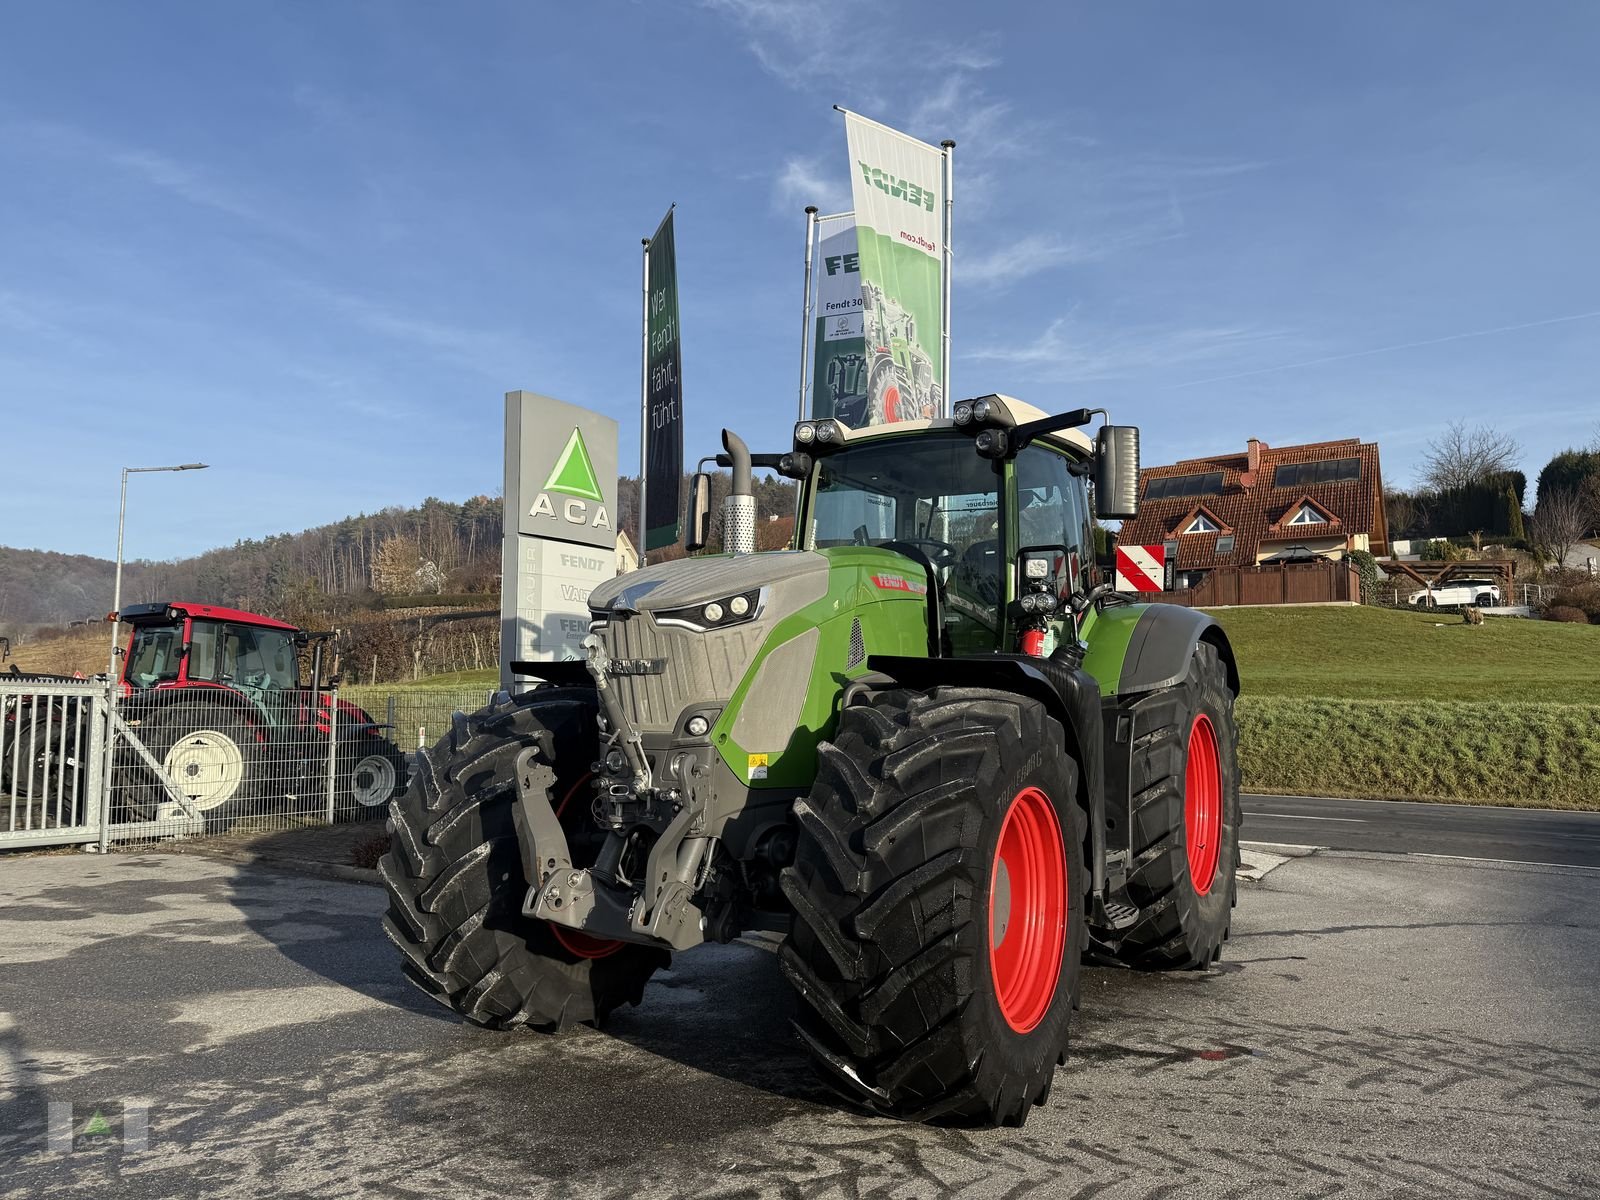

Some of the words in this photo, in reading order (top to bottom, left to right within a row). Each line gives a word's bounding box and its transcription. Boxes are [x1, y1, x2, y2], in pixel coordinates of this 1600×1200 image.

[824, 252, 860, 276] FE
[651, 287, 666, 319] Wer
[826, 300, 850, 310] Fendt
[652, 315, 676, 357] Fendt
[652, 397, 679, 431] führt.
[528, 493, 612, 531] ACA
[560, 553, 605, 571] FENDT
[560, 619, 590, 632] FEN
